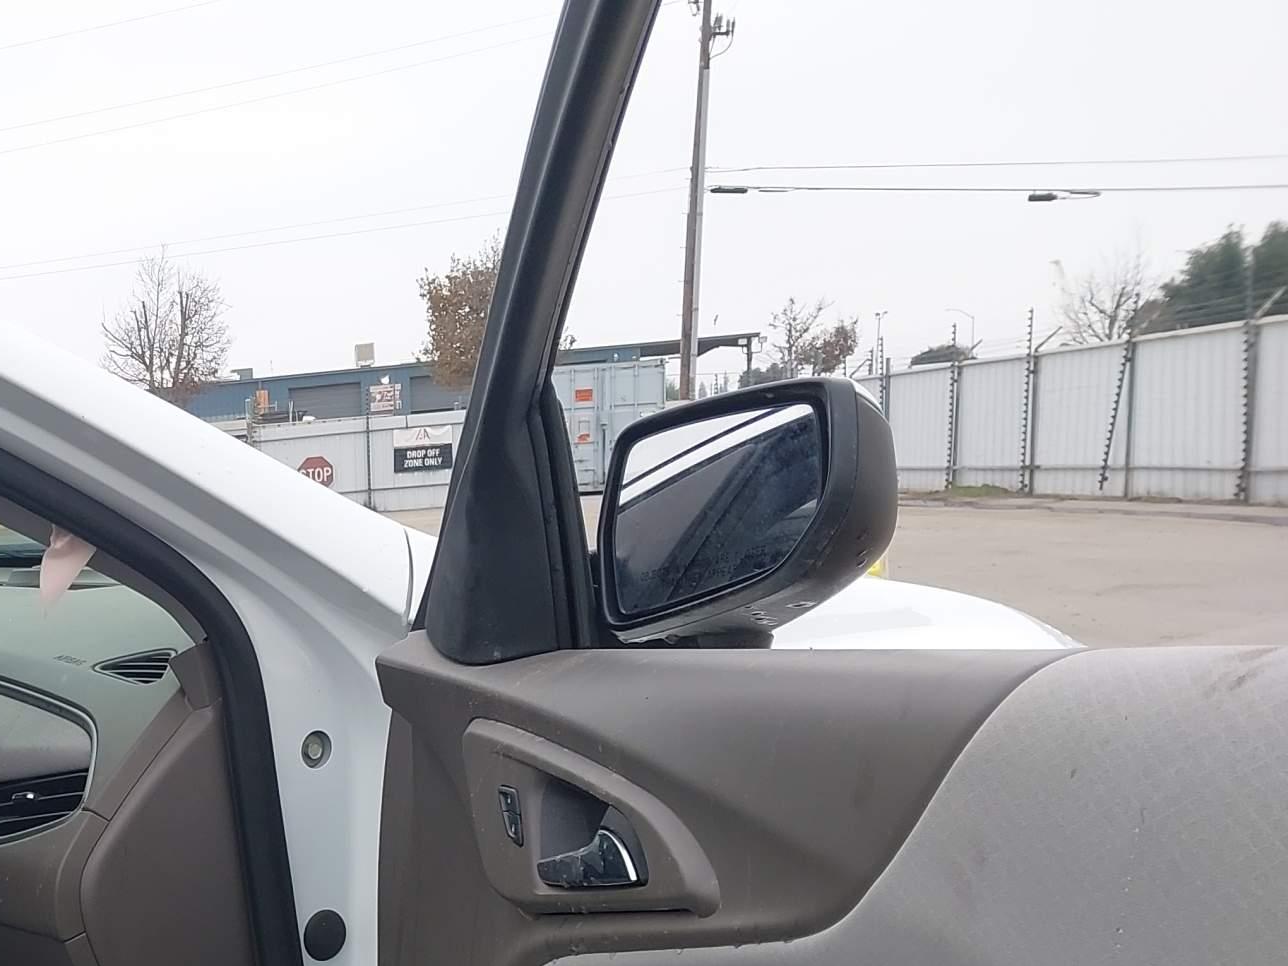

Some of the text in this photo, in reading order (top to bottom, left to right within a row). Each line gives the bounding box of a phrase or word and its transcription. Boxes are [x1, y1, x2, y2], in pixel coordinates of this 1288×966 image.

[406, 448, 440, 459] DROP OFF
[403, 457, 443, 468] ZONE ONLY
